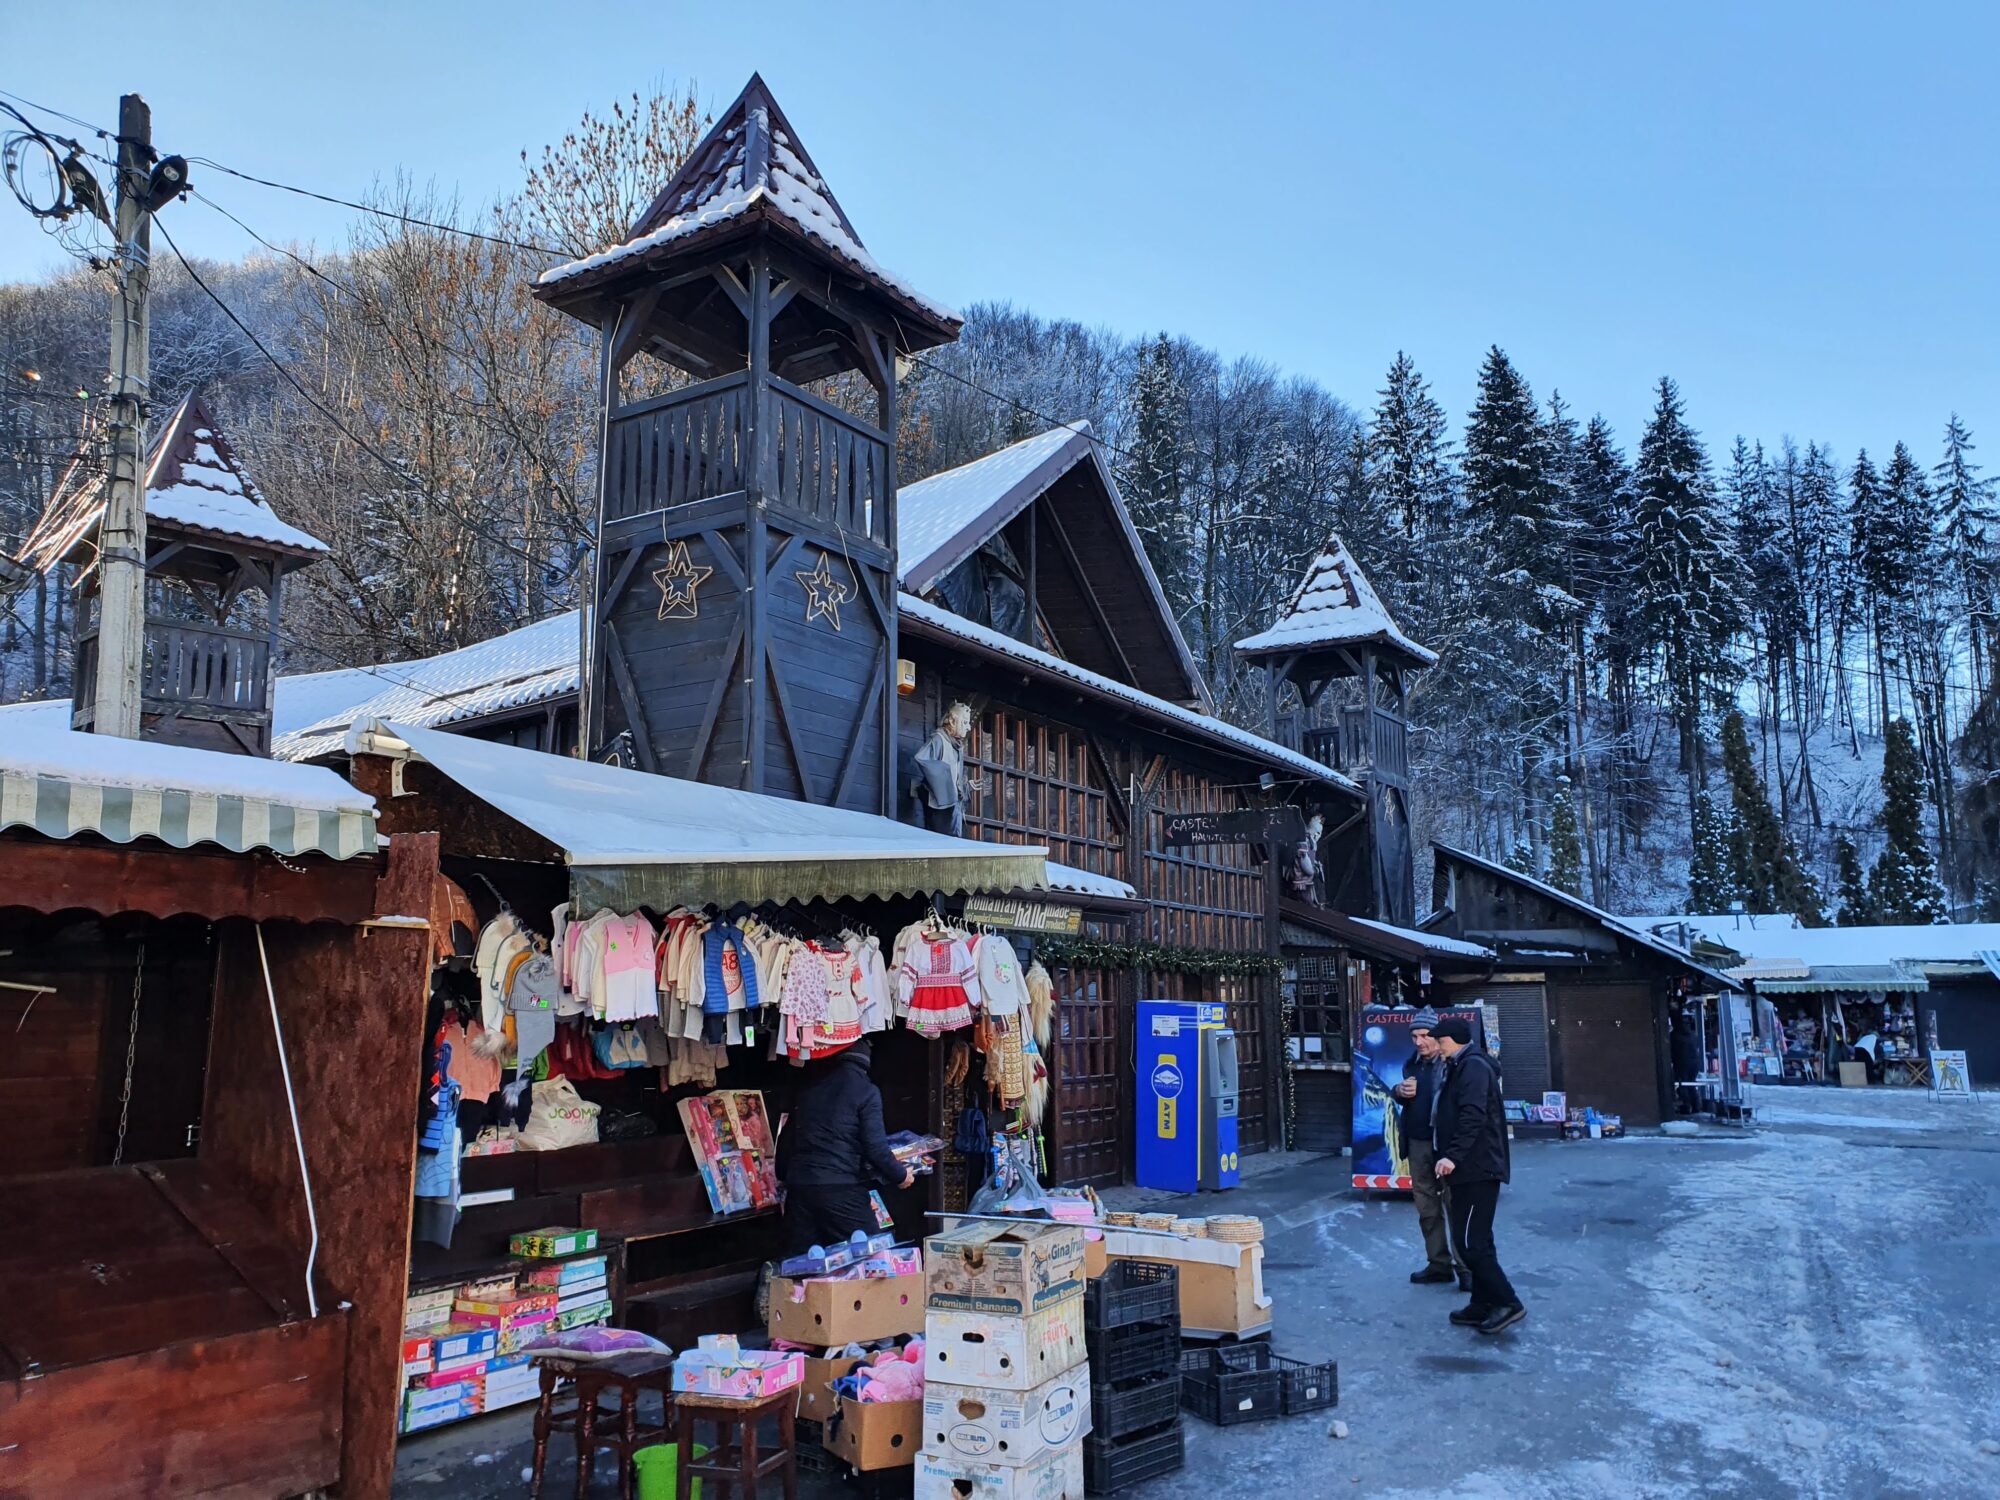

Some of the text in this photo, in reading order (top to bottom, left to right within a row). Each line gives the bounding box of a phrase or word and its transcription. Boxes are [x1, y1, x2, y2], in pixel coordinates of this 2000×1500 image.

[966, 895, 1017, 914] Romanian
[1014, 900, 1047, 929] hand
[1045, 903, 1070, 919] made
[1366, 1013, 1415, 1024] CASTELU
[1163, 1102, 1171, 1130] ATM
[932, 1298, 1019, 1313] Premium Bananas
[923, 1464, 962, 1478] Premium
